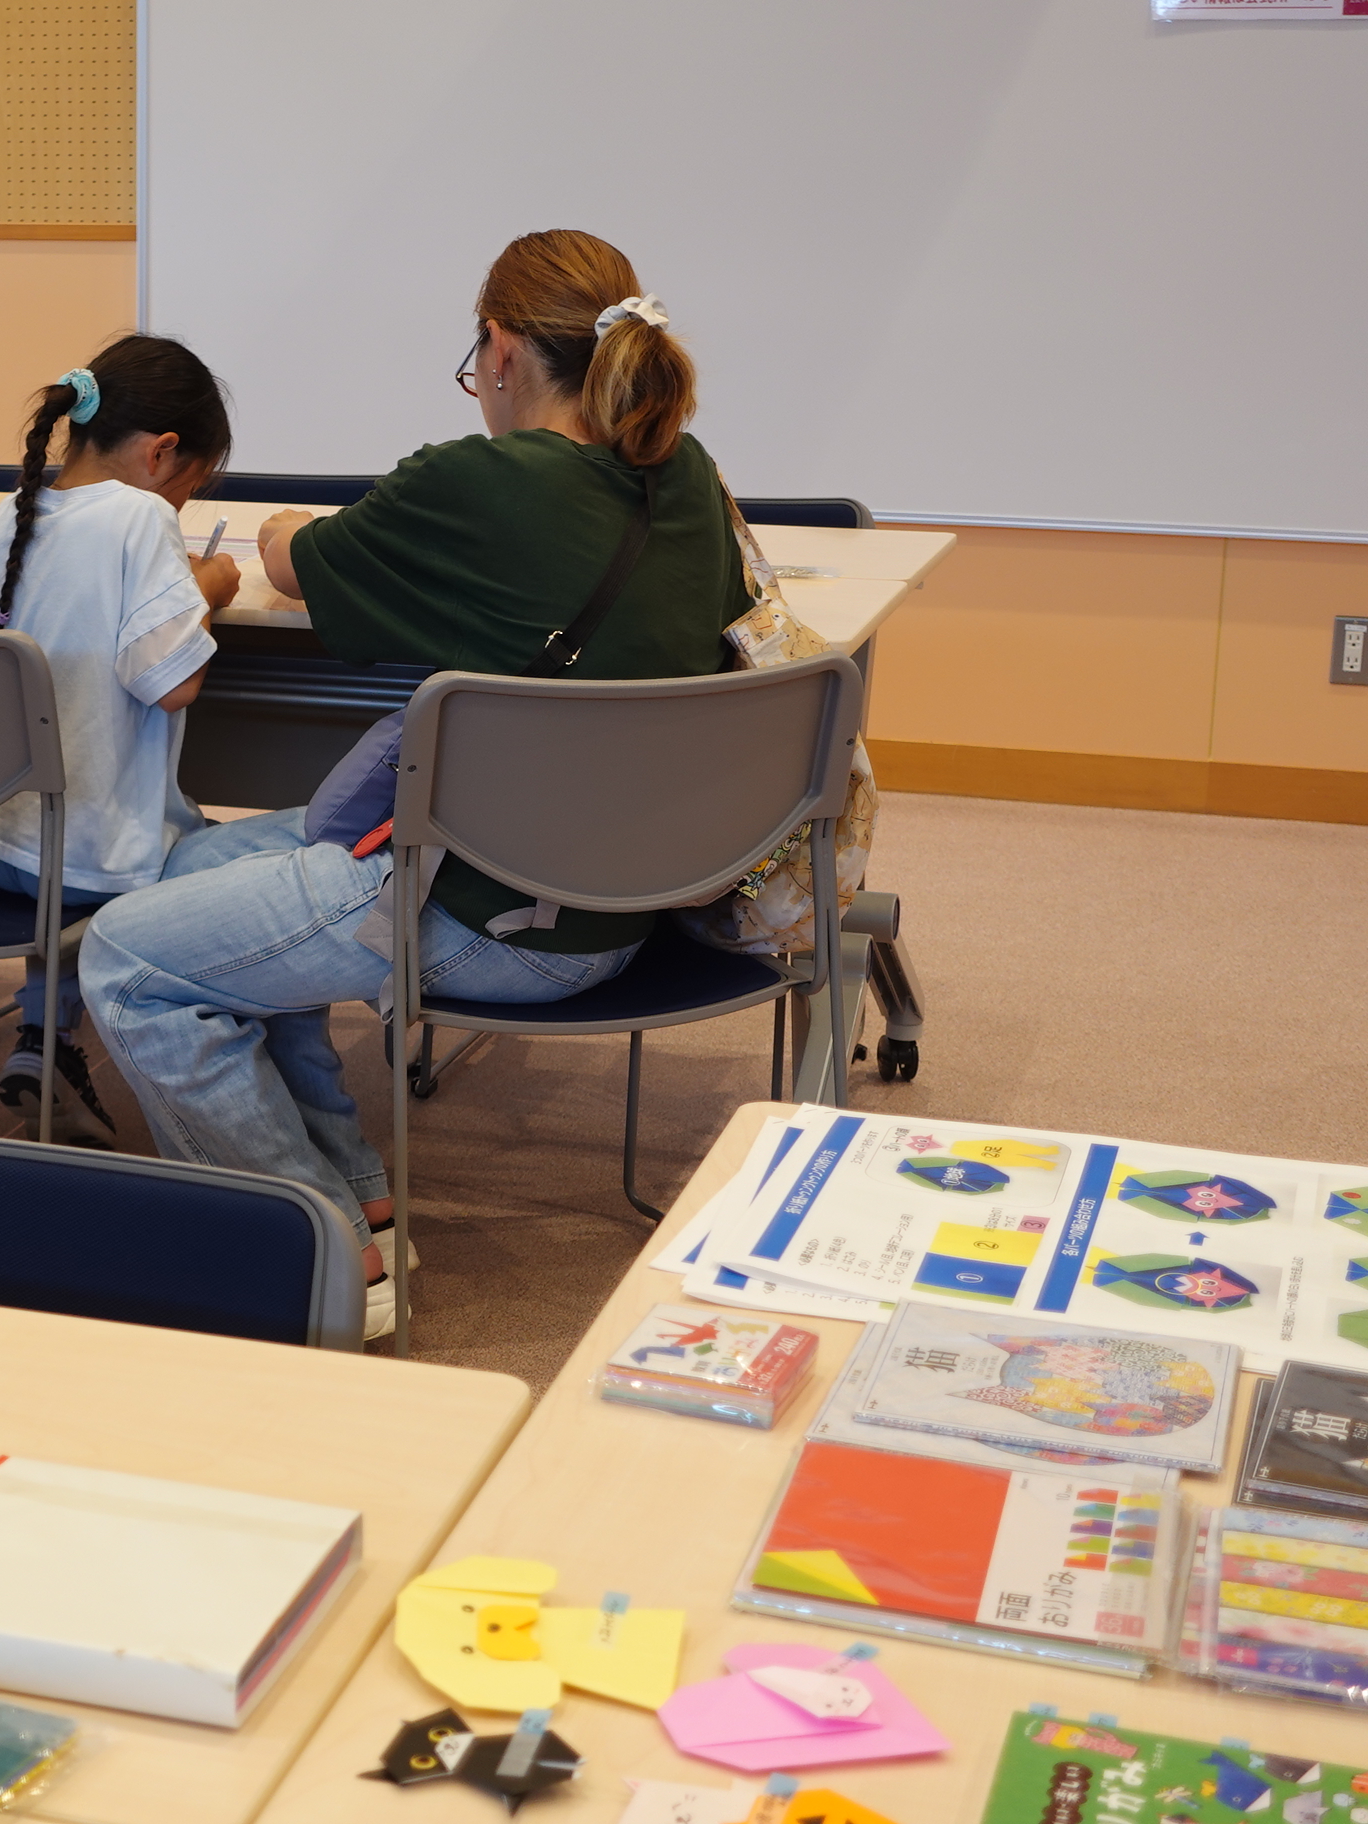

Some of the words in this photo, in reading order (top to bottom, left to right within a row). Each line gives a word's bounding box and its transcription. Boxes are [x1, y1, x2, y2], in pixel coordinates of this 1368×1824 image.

[784, 1149, 838, 1214] 折り紙トゥンクトゥンクの作り方
[1061, 1197, 1096, 1256] 各パーツの組み合わせ方
[903, 1346, 961, 1374] 猫
[1289, 1408, 1351, 1442] 猫
[994, 1590, 1032, 1622] 両面
[1034, 1568, 1079, 1628] おりがみ
[1053, 1766, 1081, 1824] い・楽しい
